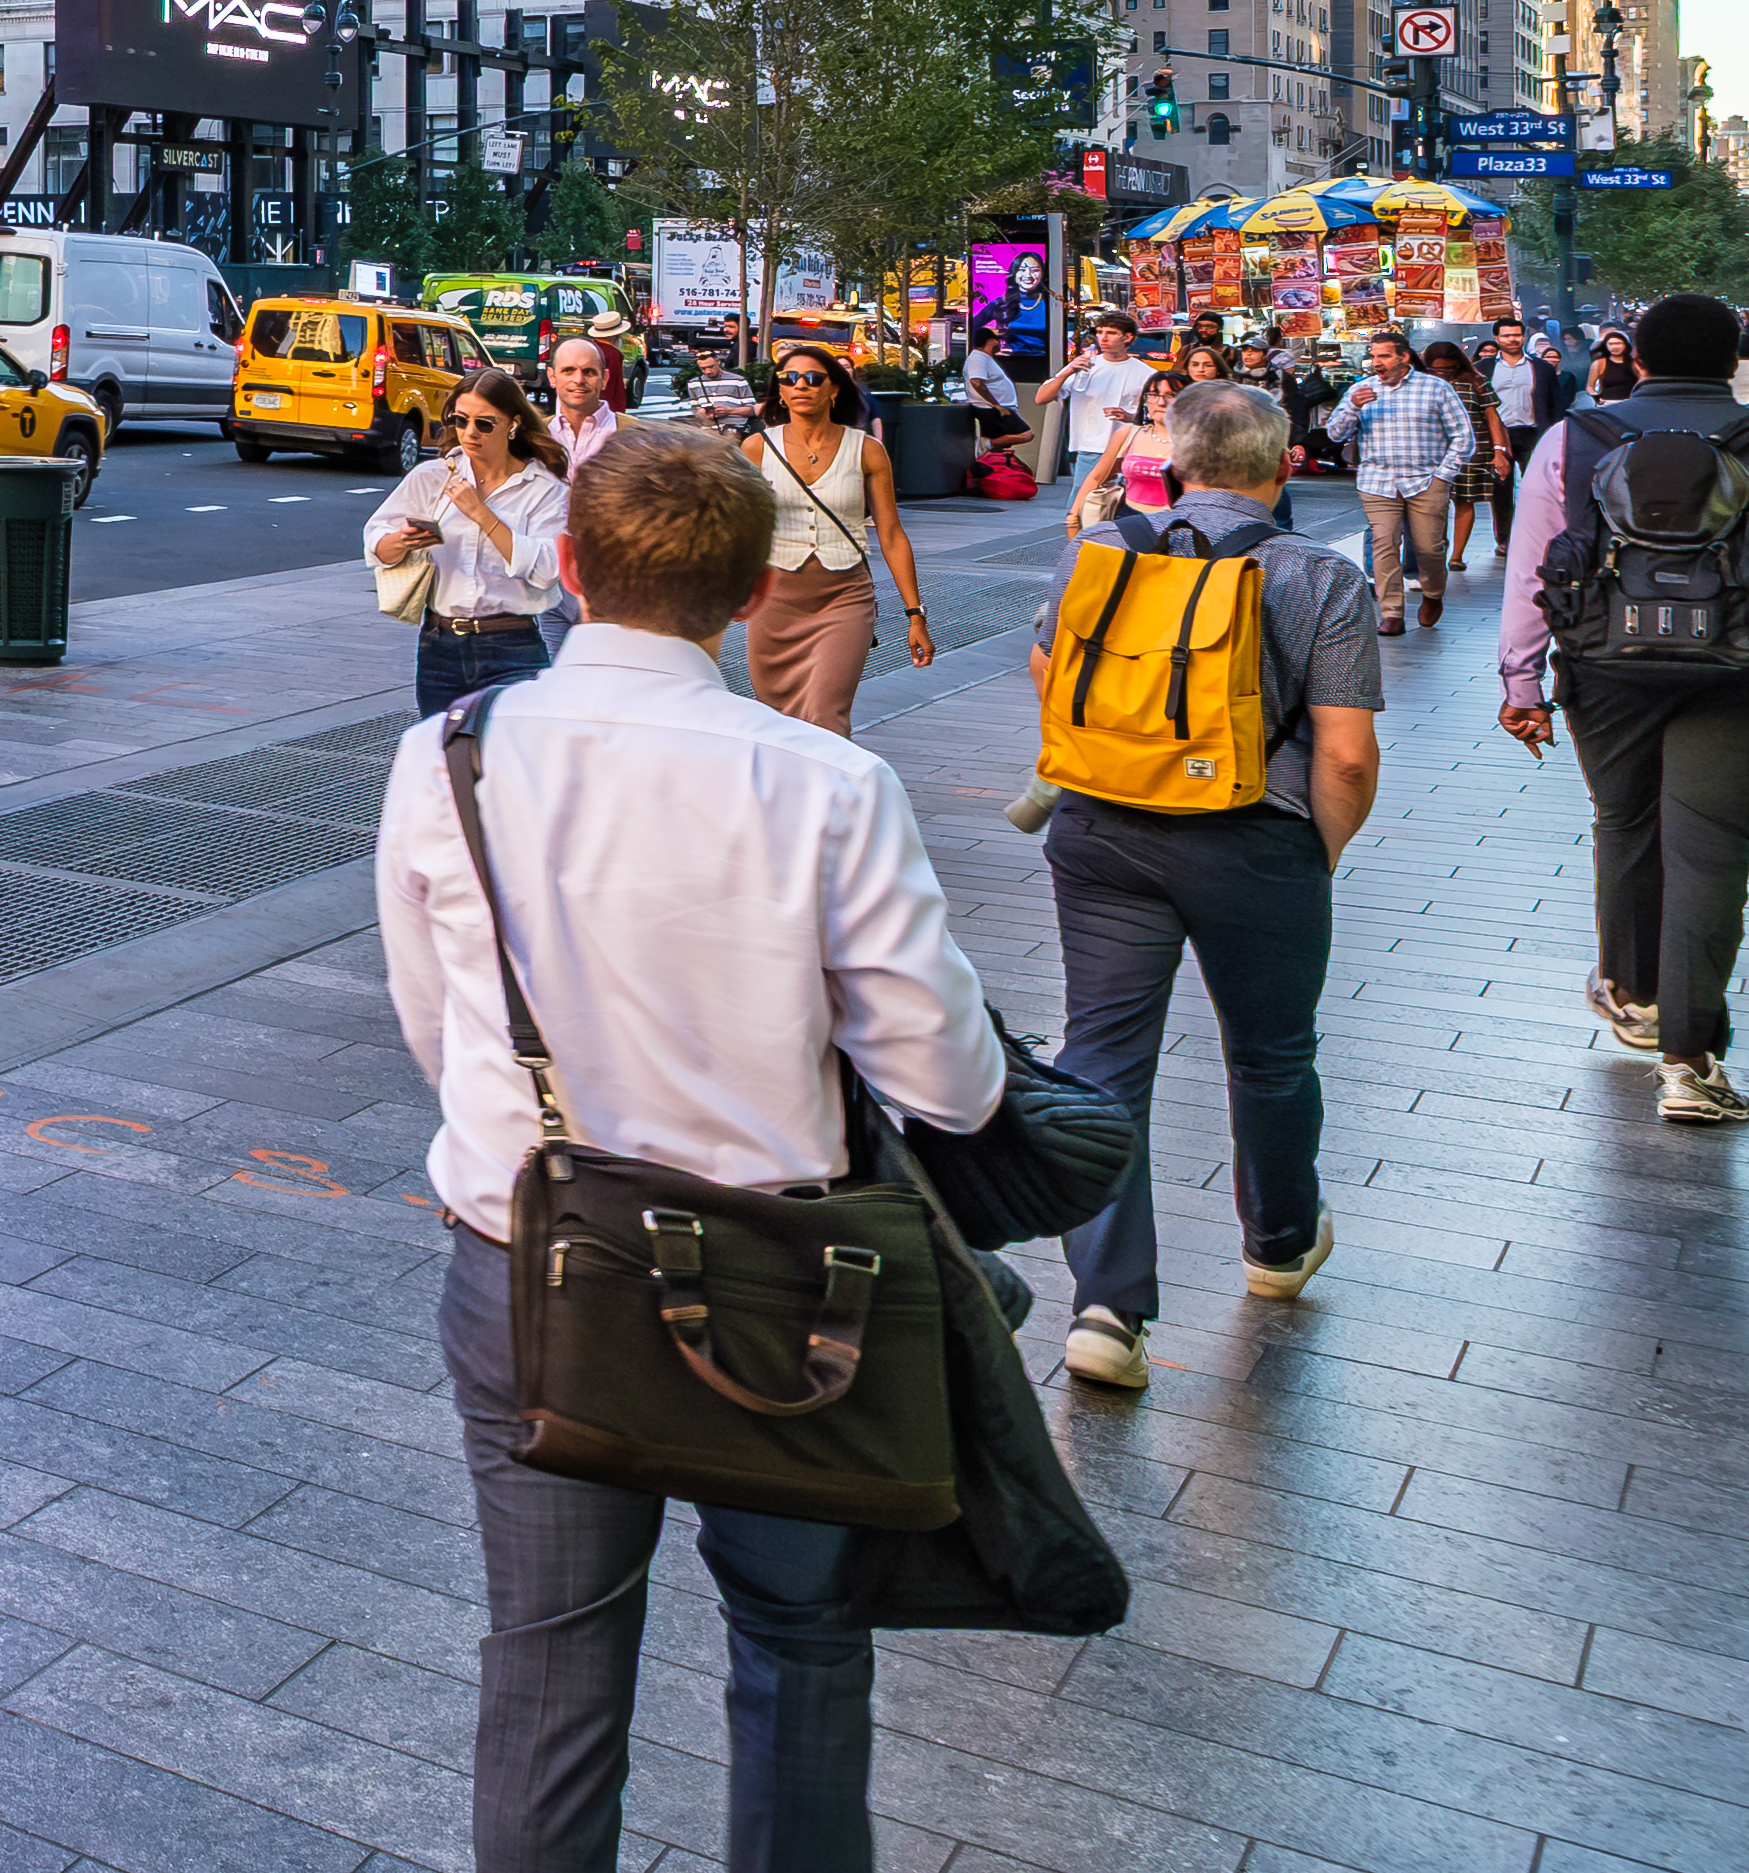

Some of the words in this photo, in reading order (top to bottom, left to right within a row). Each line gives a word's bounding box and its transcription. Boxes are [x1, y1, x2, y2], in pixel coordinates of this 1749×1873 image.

[1459, 122, 1504, 136] West
[1508, 119, 1543, 136] 33rd
[1546, 121, 1567, 135] St
[1477, 156, 1547, 172] Plaza33
[1587, 174, 1621, 185] West
[2, 200, 55, 225] ENN
[485, 290, 536, 309] RDS
[558, 288, 583, 314] RDS
